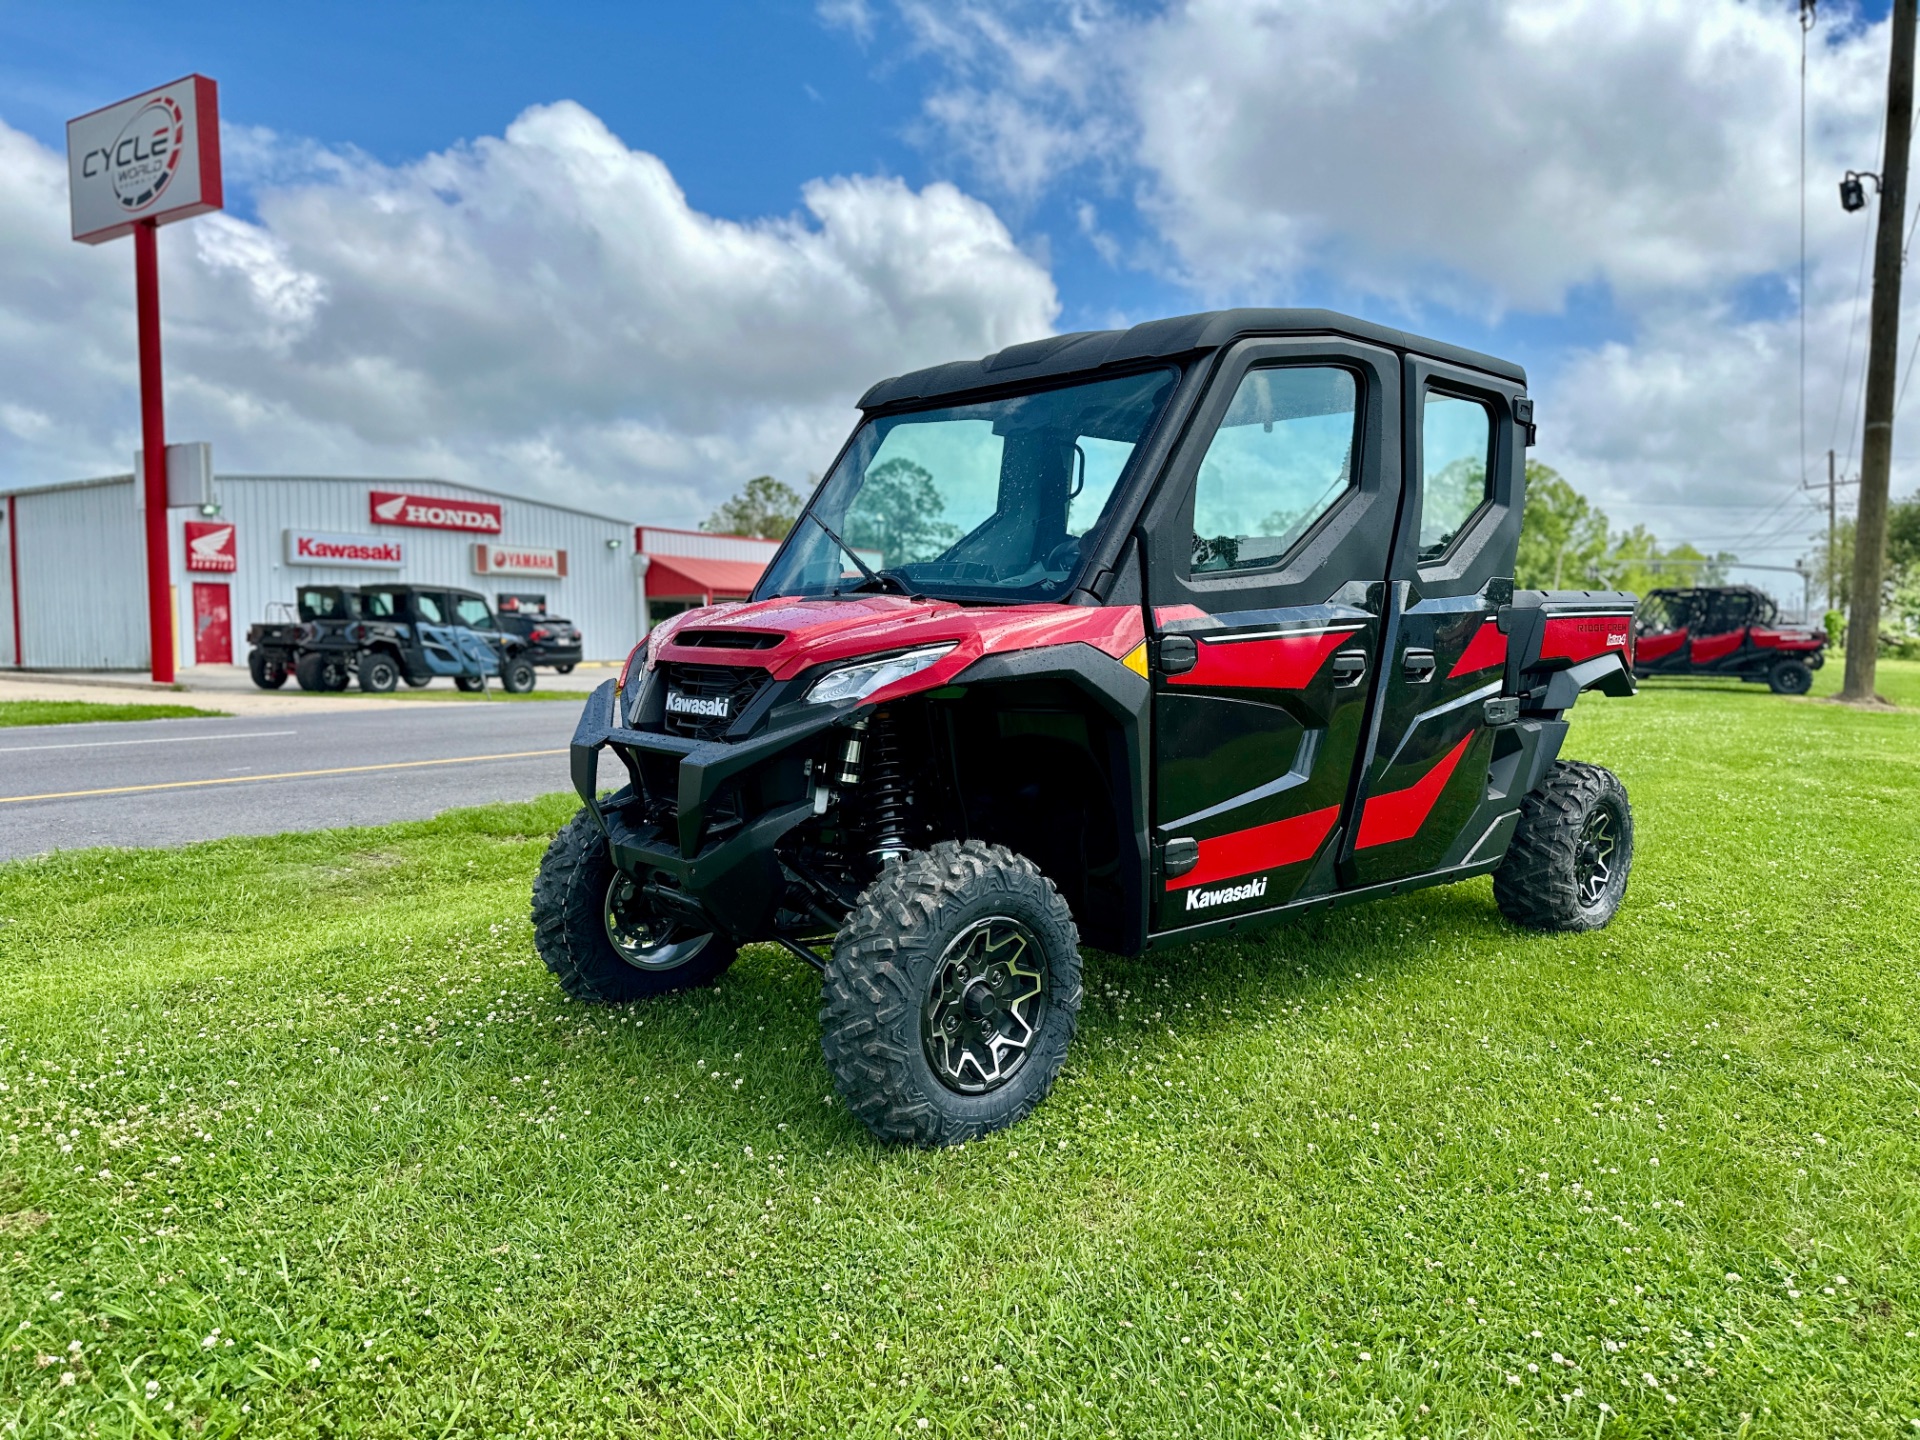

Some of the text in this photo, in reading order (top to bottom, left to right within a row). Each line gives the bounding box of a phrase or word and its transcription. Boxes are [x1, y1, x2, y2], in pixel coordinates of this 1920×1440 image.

[83, 127, 169, 178] CYCLE
[118, 160, 163, 182] WORLD
[406, 505, 500, 530] HONDA
[298, 538, 401, 562] Kawasaki
[508, 553, 555, 570] YAMAHA
[1577, 624, 1627, 632] RIDGE CREW
[665, 692, 729, 718] Kawasaki
[1185, 877, 1267, 911] Kawasaki
